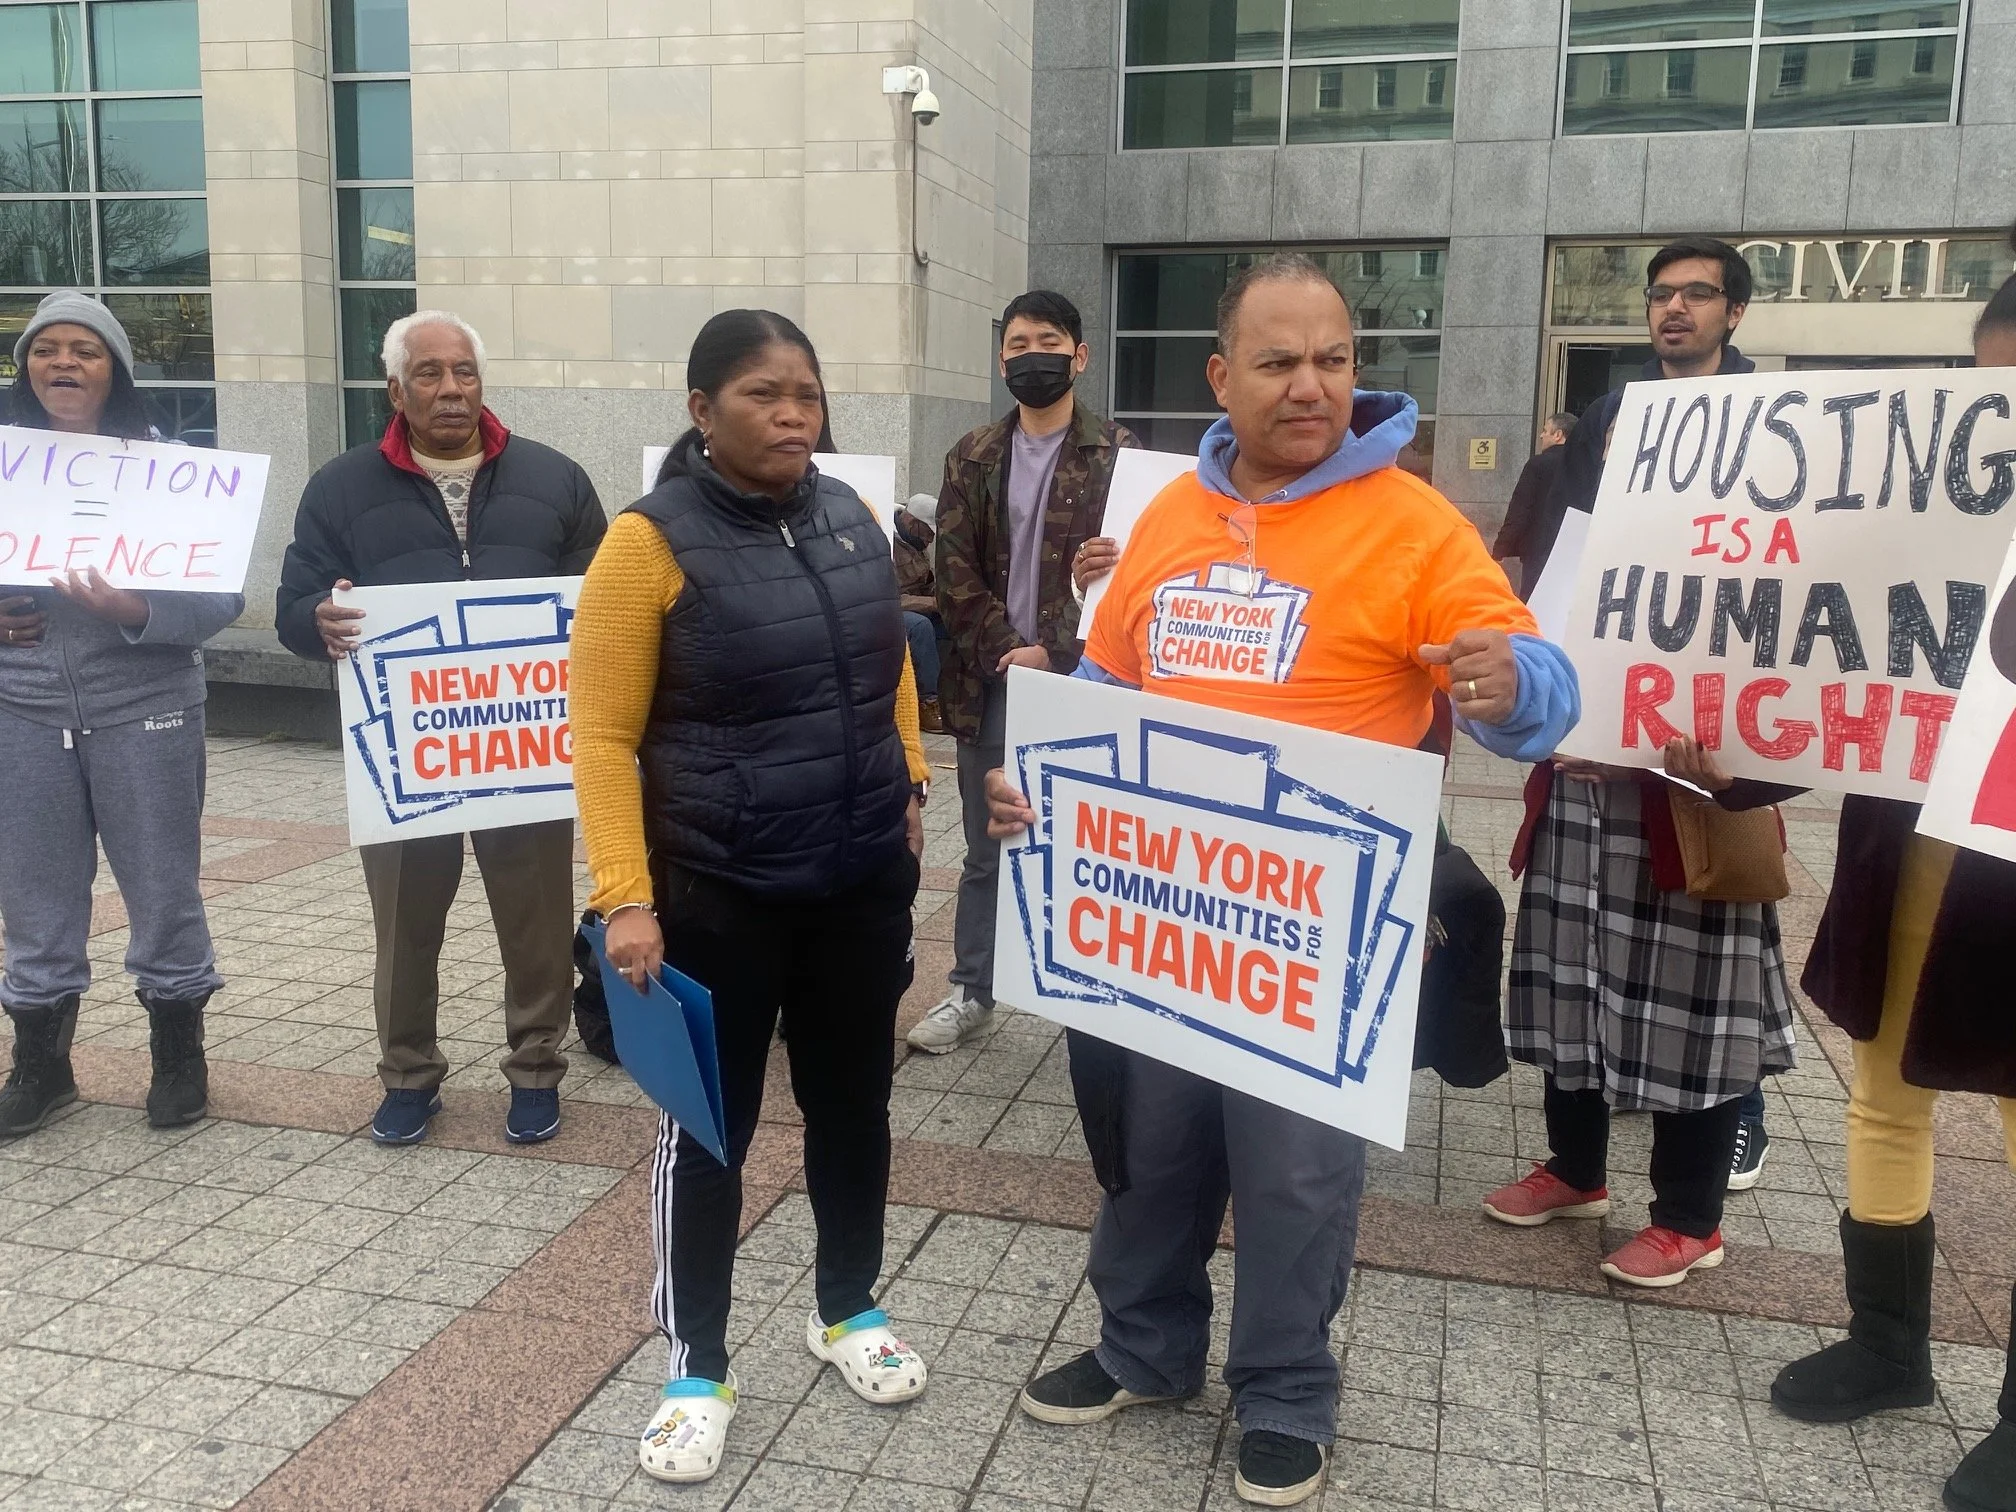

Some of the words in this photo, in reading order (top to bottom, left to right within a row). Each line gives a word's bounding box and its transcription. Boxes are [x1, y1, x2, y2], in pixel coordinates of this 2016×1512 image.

[1736, 238, 1970, 301] CIVIL
[2, 440, 242, 498] VICTION
[1626, 389, 2016, 515] HOUSING
[1691, 514, 1752, 564] IS
[1763, 517, 1800, 564] A
[1167, 620, 1263, 645] COMMUNITIES
[1263, 631, 1272, 645] FOR
[1170, 597, 1218, 622] NEW
[1221, 602, 1276, 629] YORK
[1593, 564, 1987, 690] HUMAN
[410, 664, 500, 705] NEW
[1161, 637, 1268, 676] CHANGE
[144, 718, 184, 731] Roots
[1621, 662, 1960, 783] RIGHT
[1075, 801, 1182, 875] NEW
[1190, 831, 1326, 918] YORK
[1073, 857, 1302, 952] COMMUNITIES
[1306, 925, 1323, 960] FOR
[1068, 896, 1320, 1033] CHANGE
